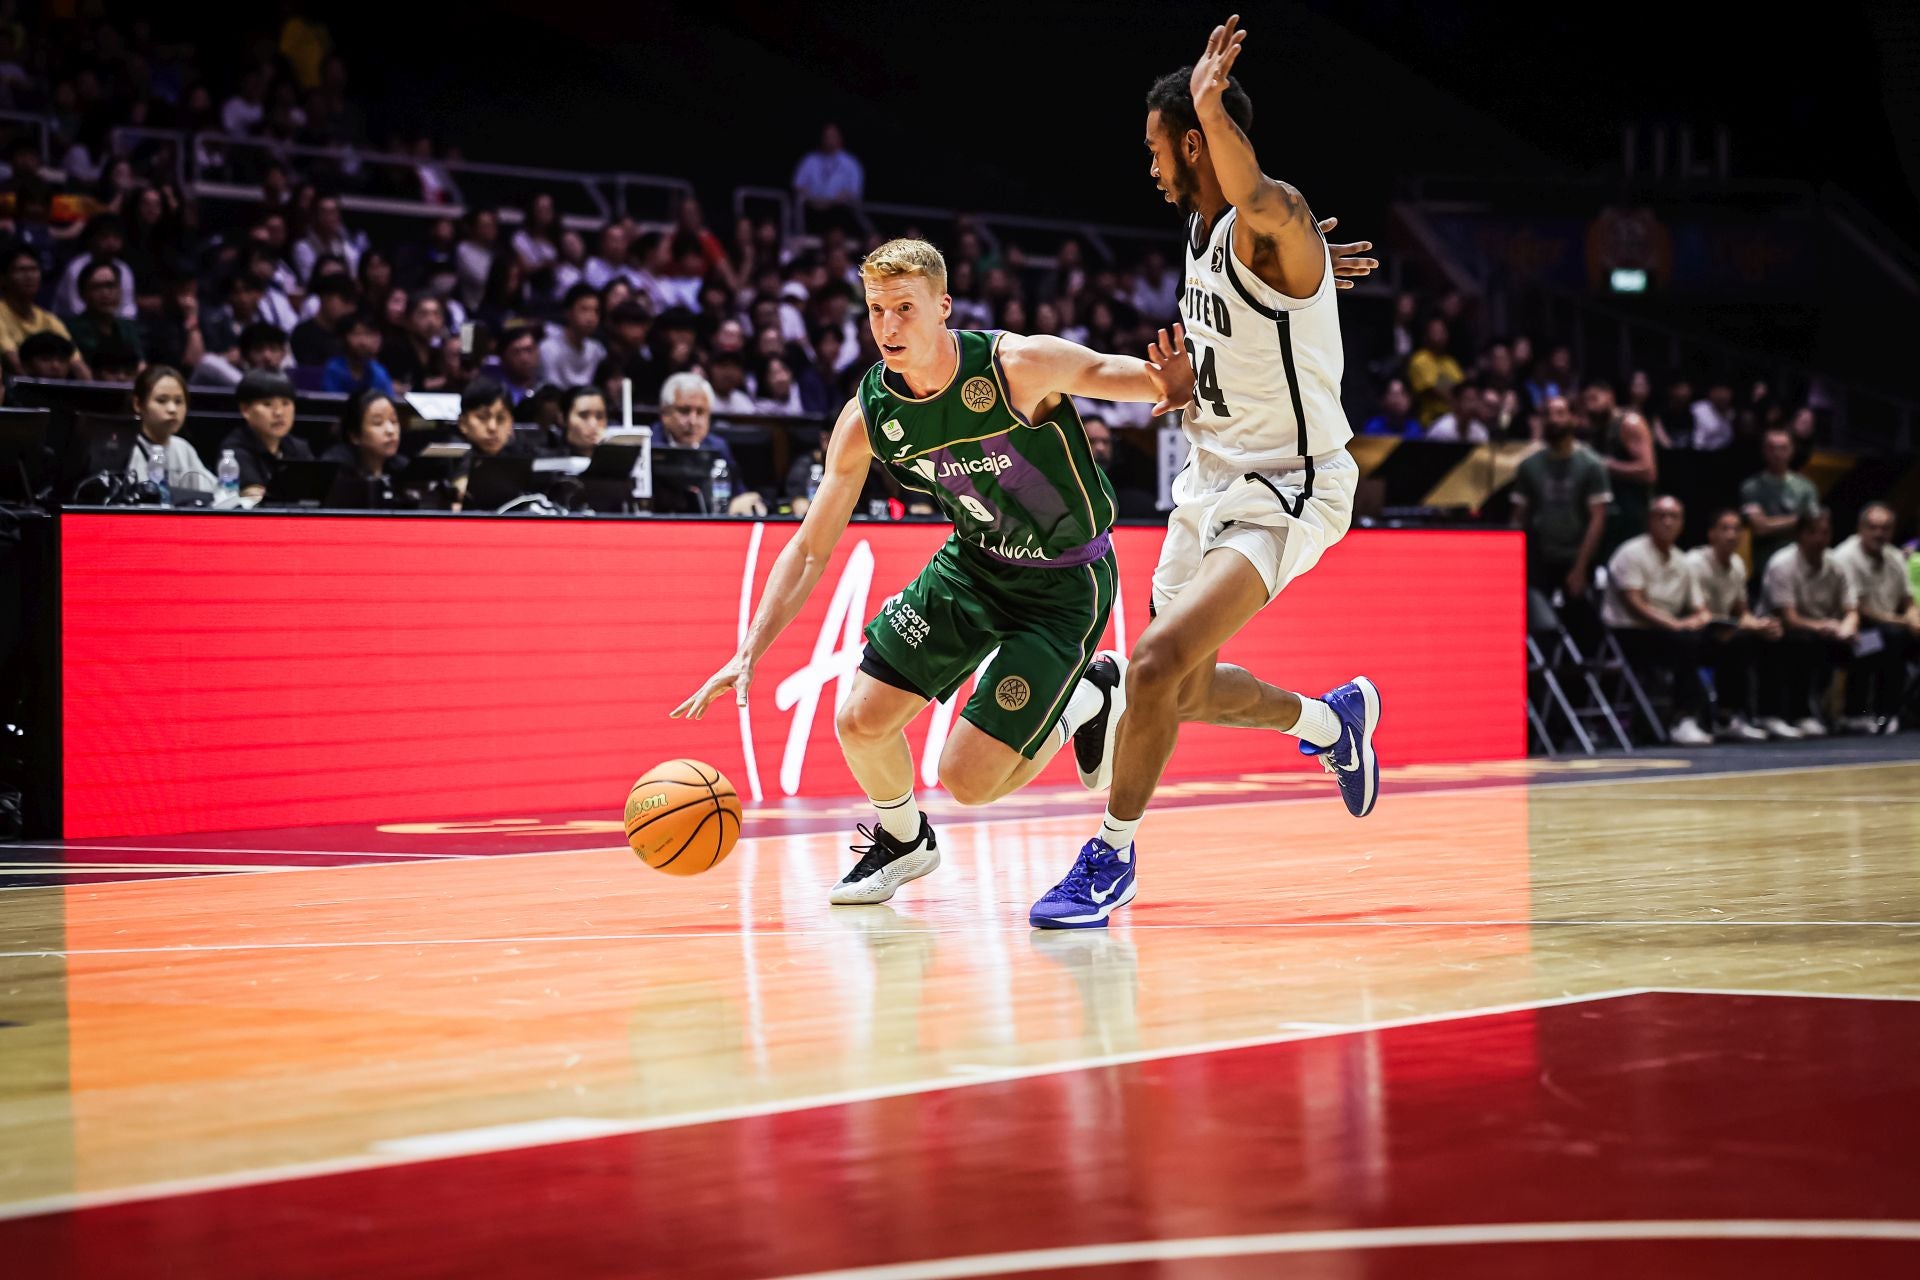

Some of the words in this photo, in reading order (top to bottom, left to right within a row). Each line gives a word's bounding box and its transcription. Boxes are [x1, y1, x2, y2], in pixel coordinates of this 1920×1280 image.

[1186, 287, 1232, 338] ITED
[958, 494, 995, 522] 9
[889, 617, 919, 650] MÁLAGA
[895, 610, 908, 628] DEL
[907, 624, 925, 644] SOL
[901, 603, 931, 636] COSTA
